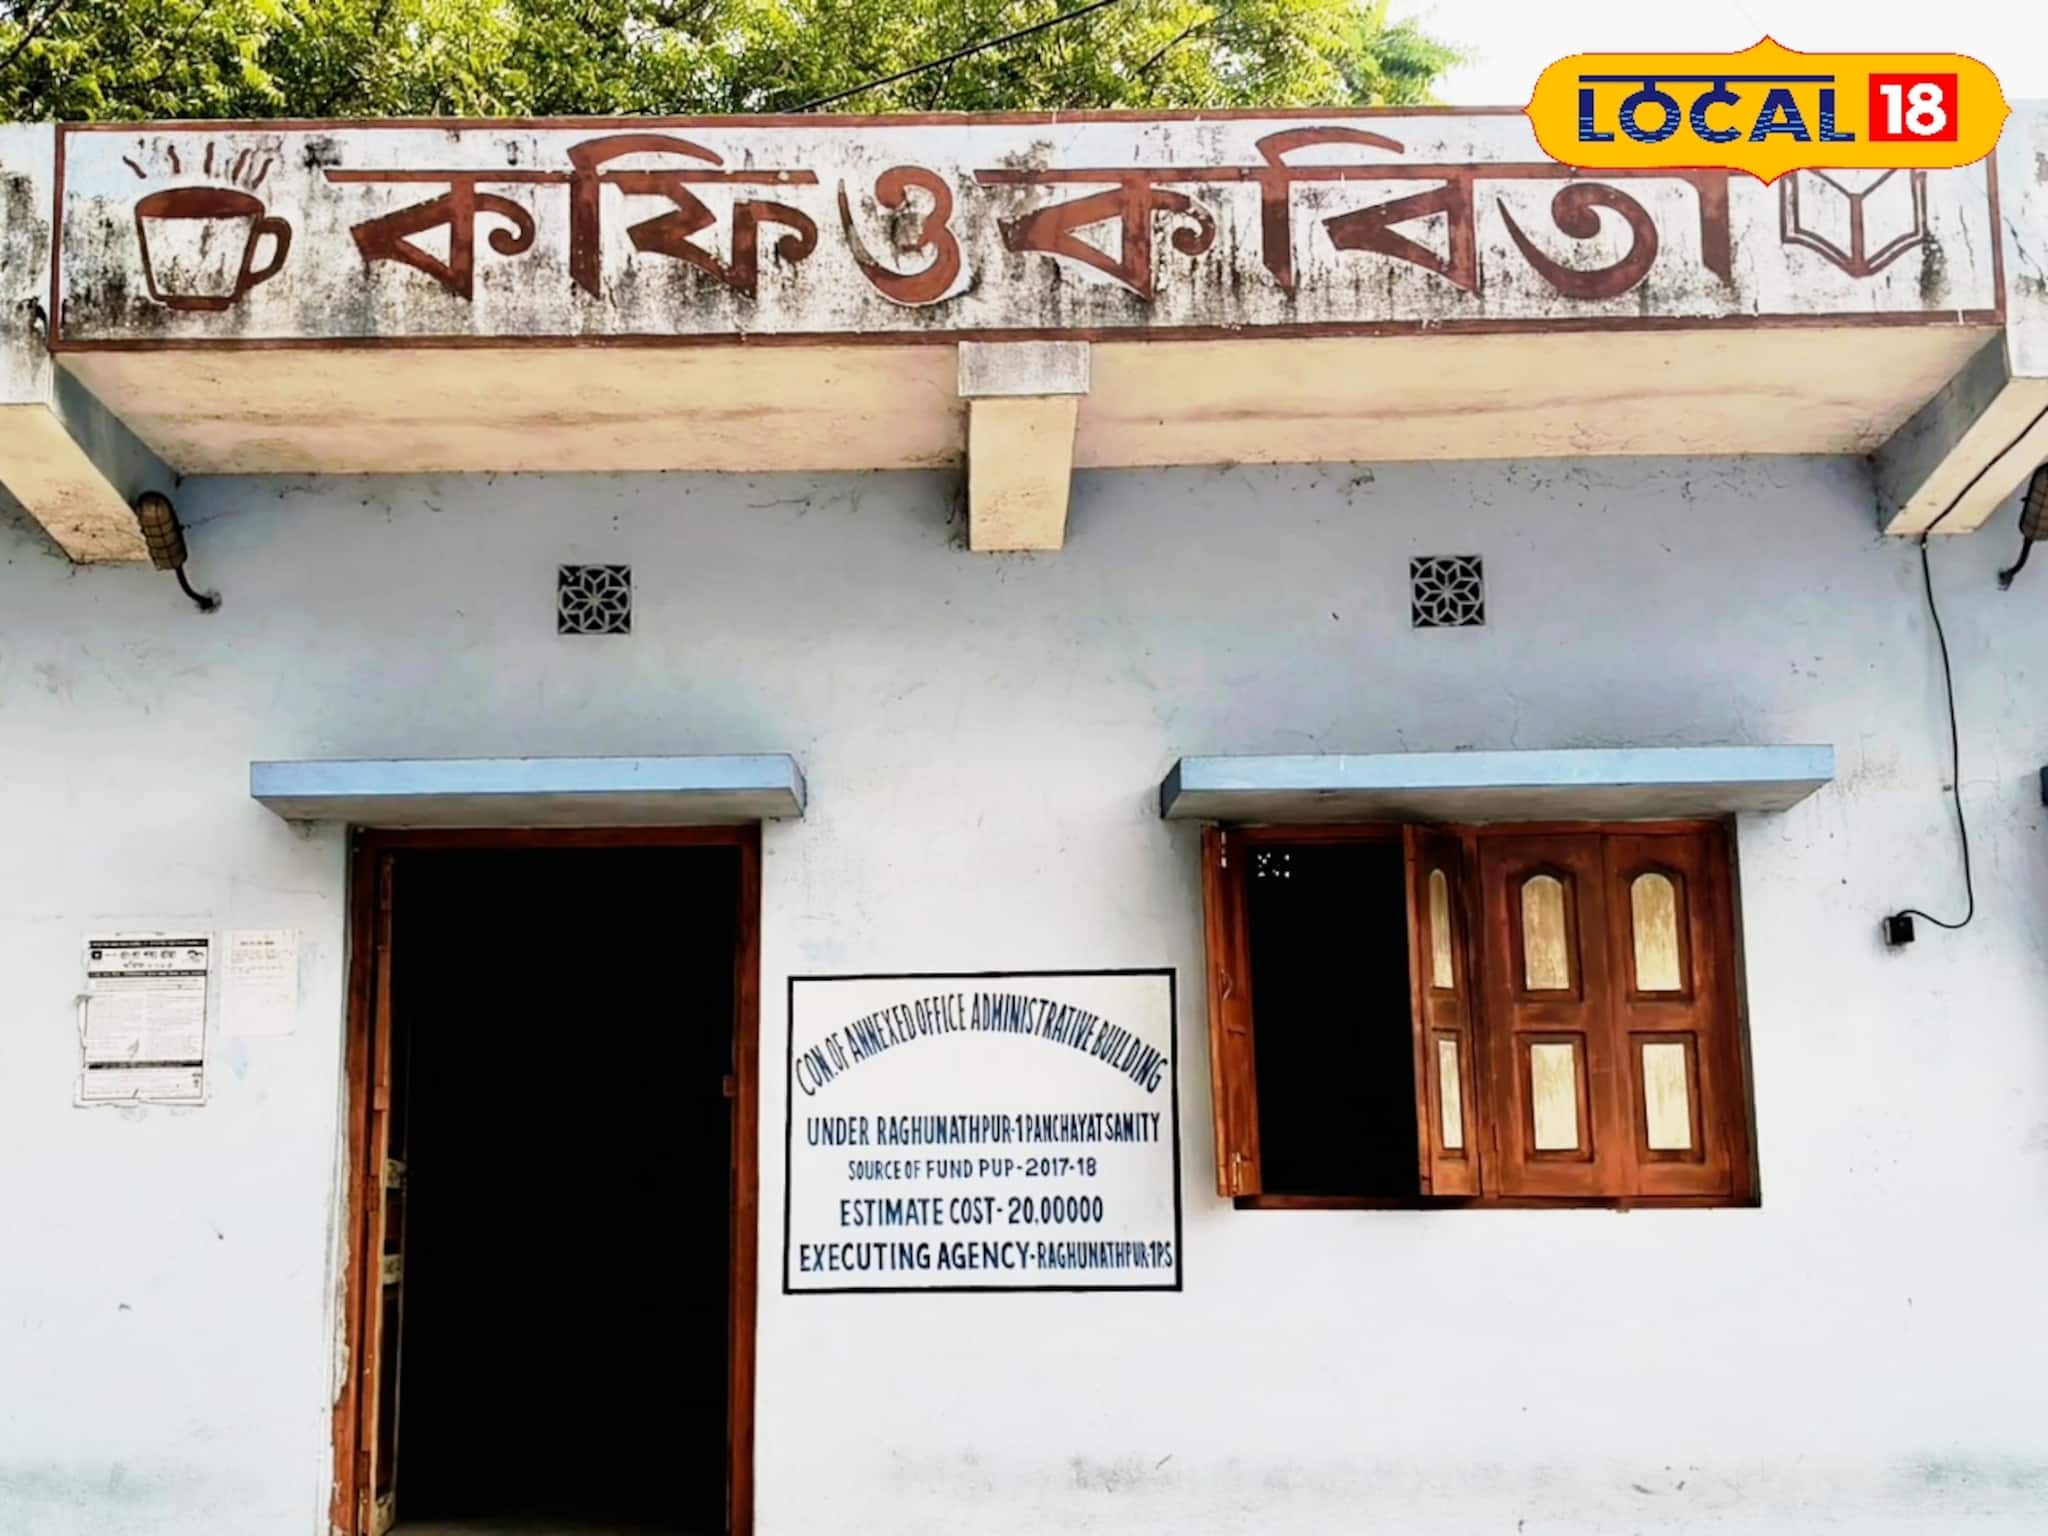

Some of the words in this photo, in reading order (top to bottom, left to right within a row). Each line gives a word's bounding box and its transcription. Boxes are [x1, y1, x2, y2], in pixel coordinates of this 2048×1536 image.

[324, 133, 819, 300] কফি
[837, 165, 962, 307] ও
[974, 126, 1734, 301] কবিতা
[914, 993, 967, 1036] OFFICE
[971, 992, 1100, 1051] ADMINISTRATIVE
[1090, 1021, 1168, 1094] BUILDING
[807, 1116, 869, 1146] UNDER
[848, 1160, 902, 1181] SOURCE
[904, 1159, 921, 1180] OF
[926, 1158, 973, 1179] FUND
[840, 1197, 943, 1226] ESTIMATE
[799, 1242, 931, 1272] EXECUTING
